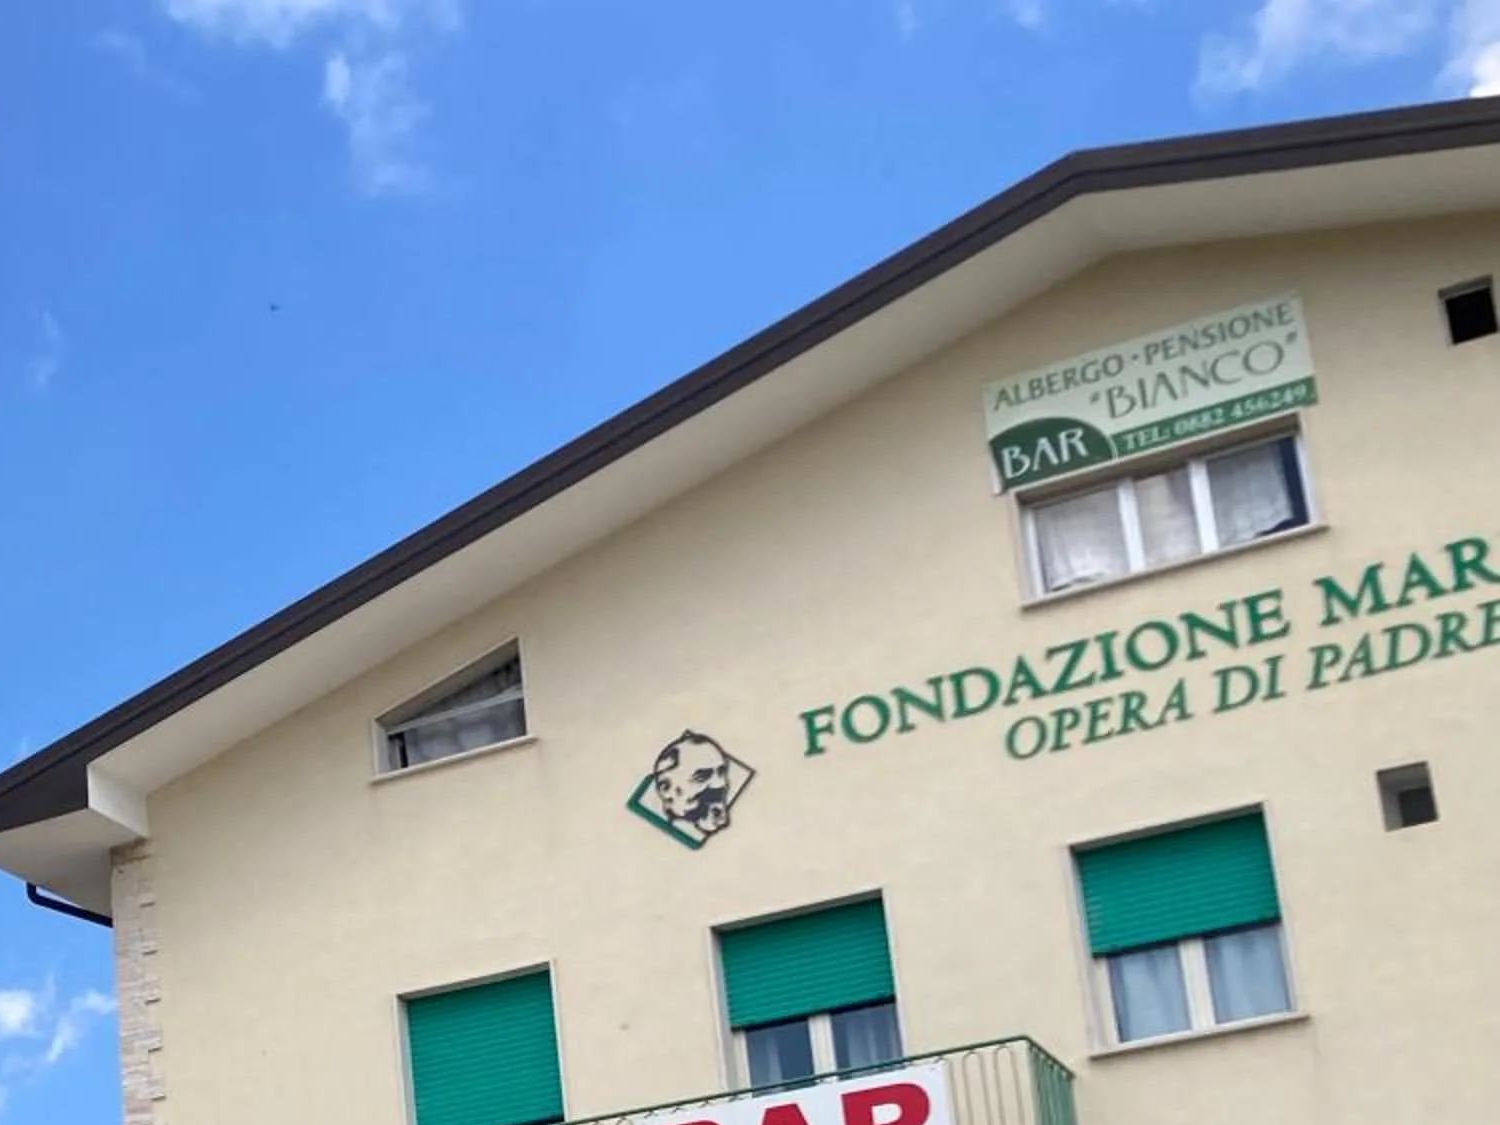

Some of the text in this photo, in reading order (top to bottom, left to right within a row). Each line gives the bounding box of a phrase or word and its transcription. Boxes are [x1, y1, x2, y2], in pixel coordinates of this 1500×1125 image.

[993, 353, 1125, 412] ALBERGO
[1143, 302, 1296, 366] PENSIONE
[1001, 427, 1089, 480] BAR
[798, 537, 1500, 758] FONDAZIONE MAR
[1004, 598, 1500, 761] OPERA DI PADRE
